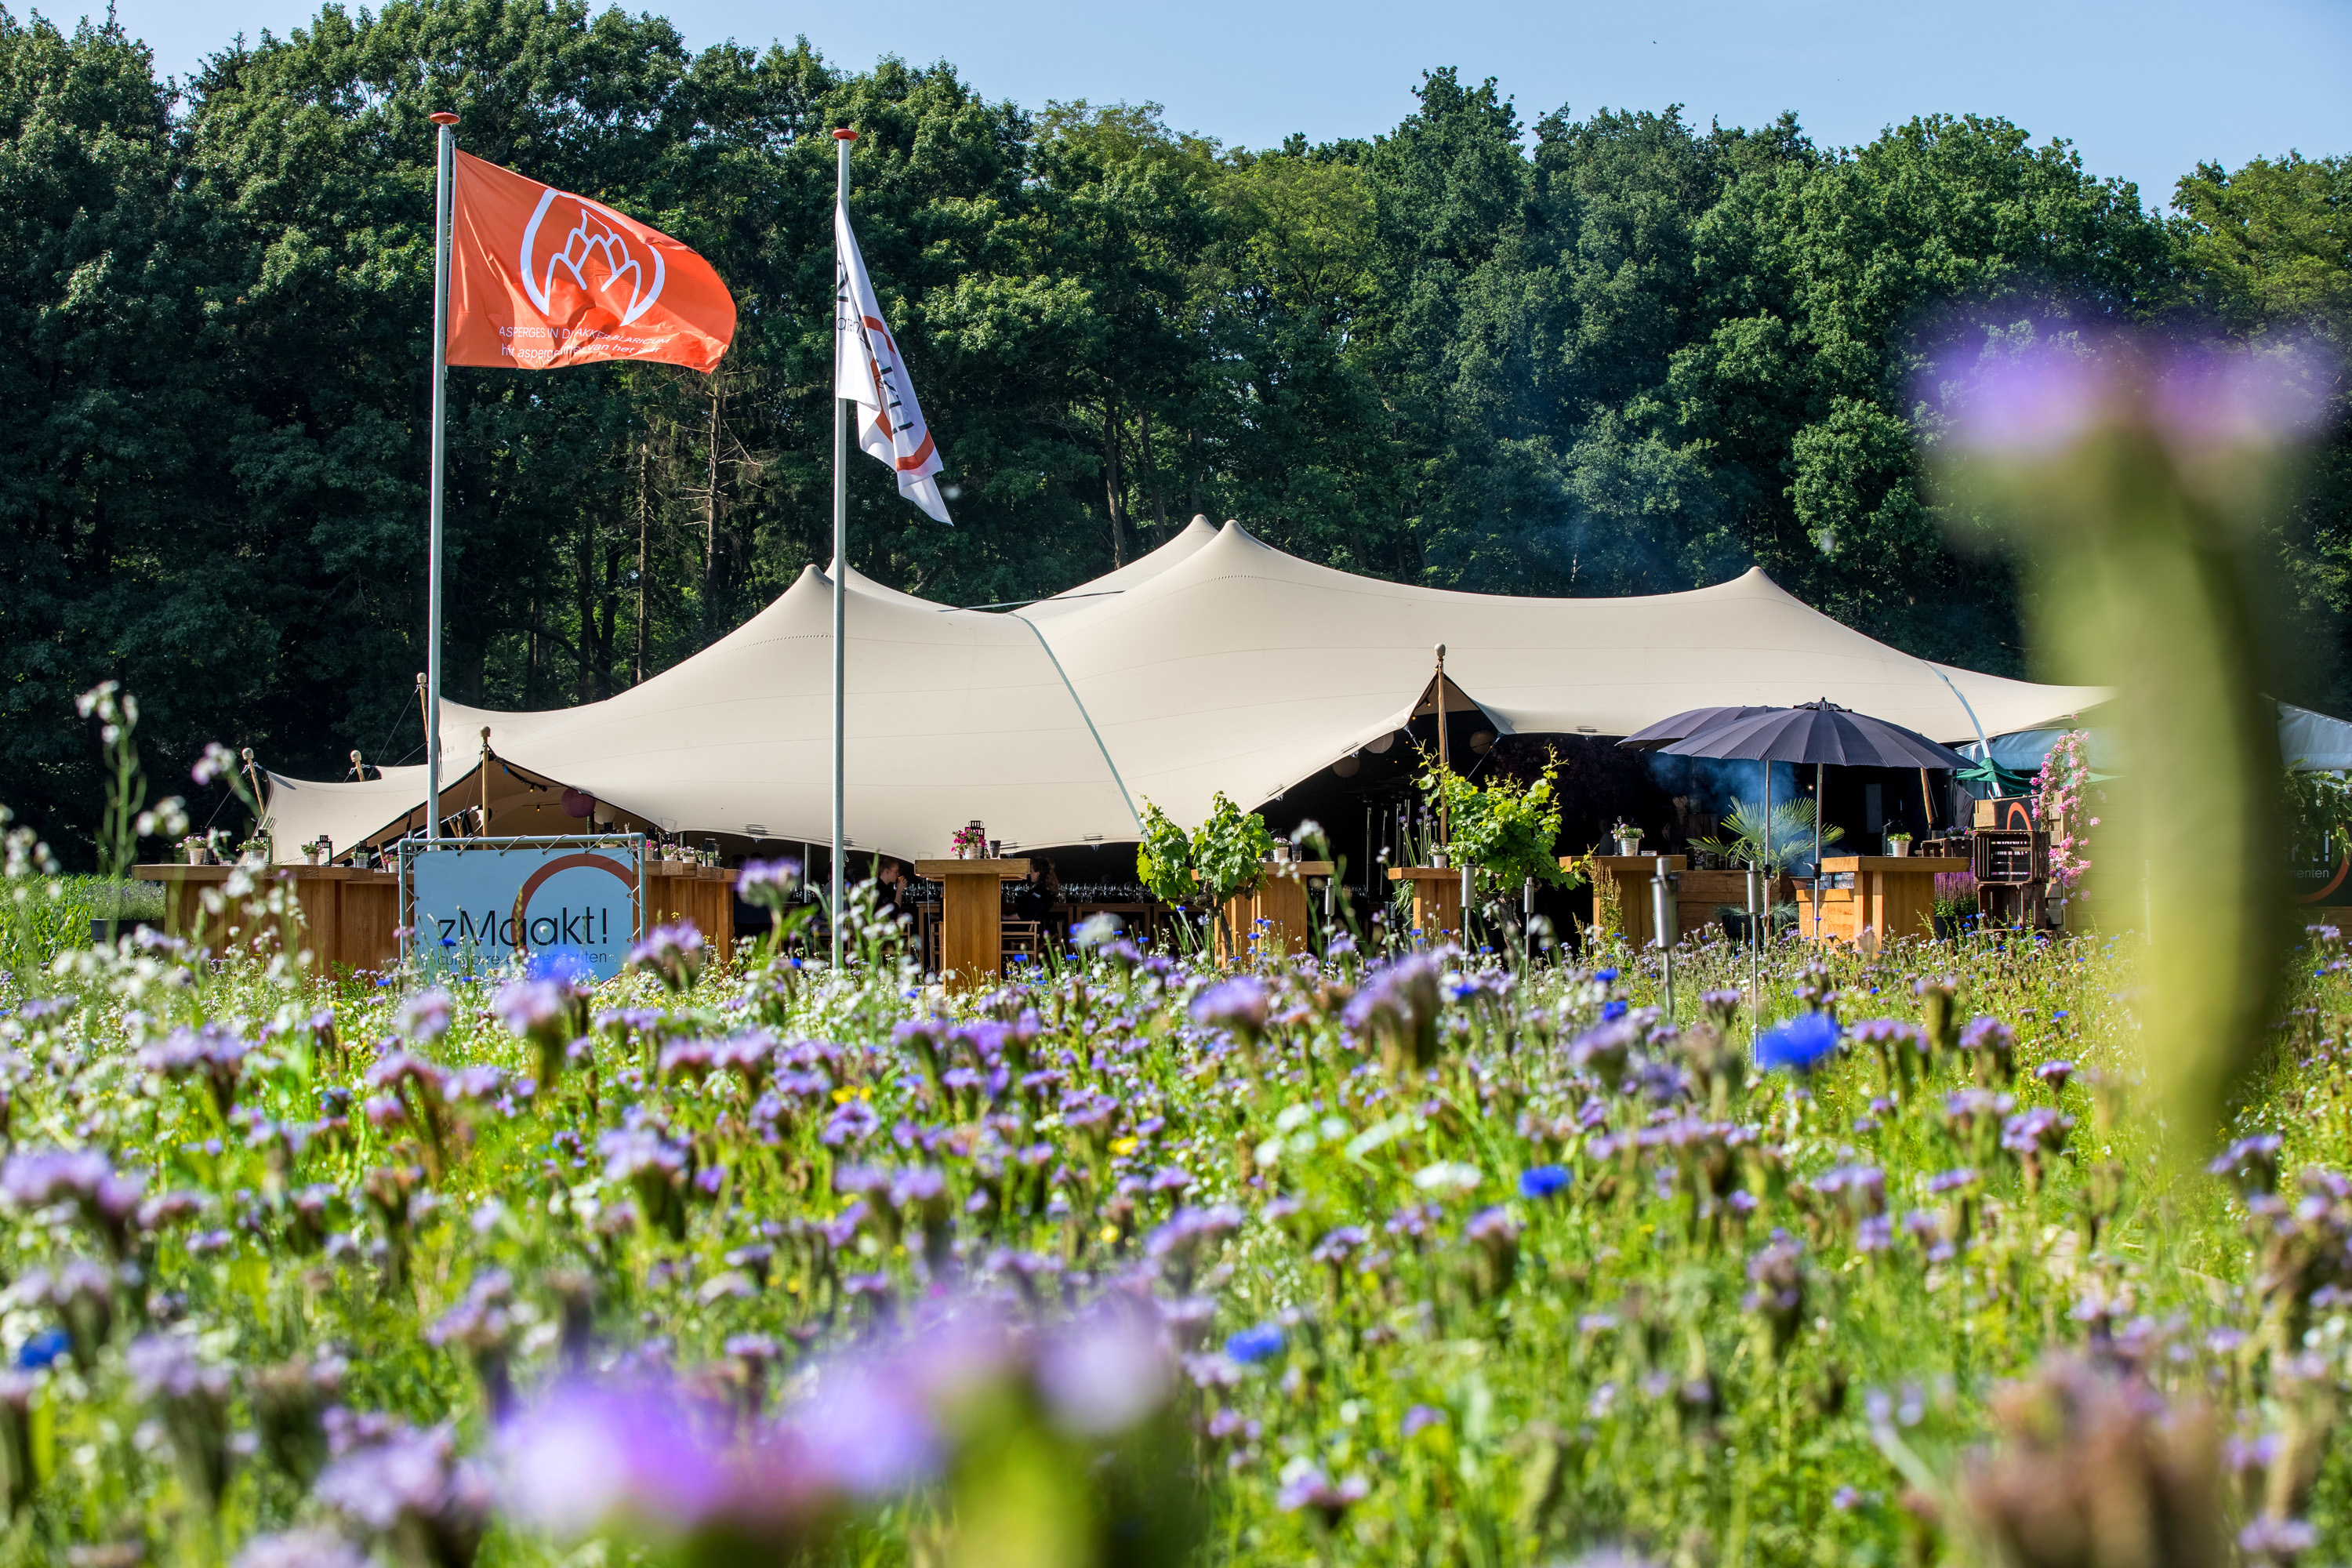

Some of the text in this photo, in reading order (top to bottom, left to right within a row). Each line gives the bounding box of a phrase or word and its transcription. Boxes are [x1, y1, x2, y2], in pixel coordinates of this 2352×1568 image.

[499, 325, 546, 338] ASPERGES
[547, 327, 559, 339] IN
[574, 328, 611, 340] AKKER
[611, 335, 671, 345] BLARICUM
[587, 343, 610, 351] van
[612, 343, 635, 354] het
[438, 906, 608, 947] zMaakt!
[437, 950, 500, 966] culnare
